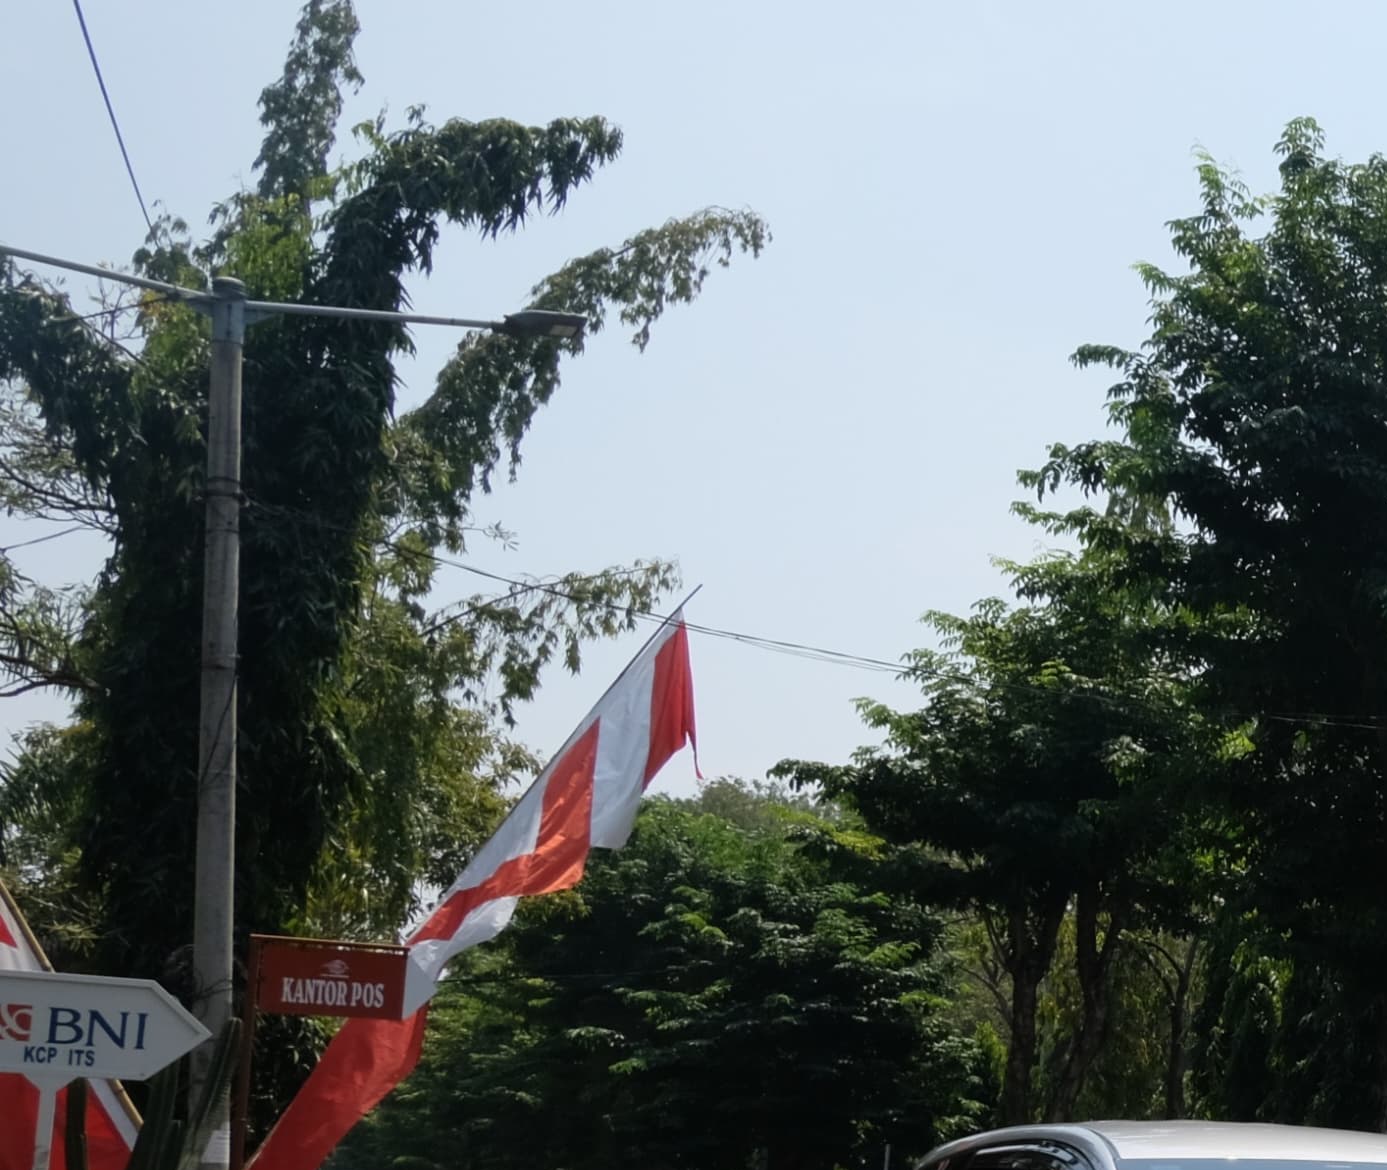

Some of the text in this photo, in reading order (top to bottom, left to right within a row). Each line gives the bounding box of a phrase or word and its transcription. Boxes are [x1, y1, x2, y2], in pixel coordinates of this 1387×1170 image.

[282, 977, 385, 1008] KANTOR POS
[46, 1006, 148, 1050] BNI
[23, 1046, 95, 1066] KCP ITS
